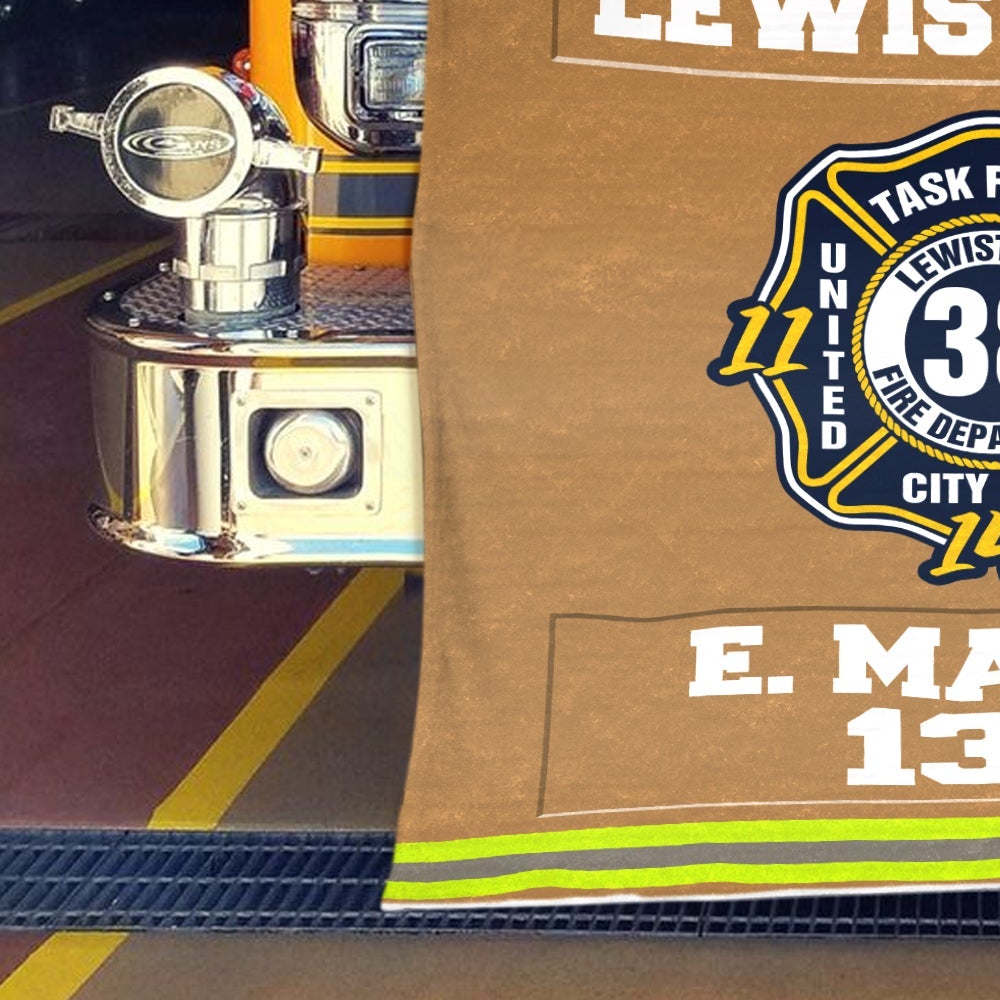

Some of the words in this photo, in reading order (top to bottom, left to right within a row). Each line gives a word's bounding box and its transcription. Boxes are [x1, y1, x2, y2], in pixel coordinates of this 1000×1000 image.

[868, 165, 975, 225] TASK
[718, 305, 814, 377] 11
[819, 242, 848, 451] UNITED
[872, 364, 933, 427] FIRE
[901, 472, 990, 505] CITY
[688, 624, 795, 697] E.
